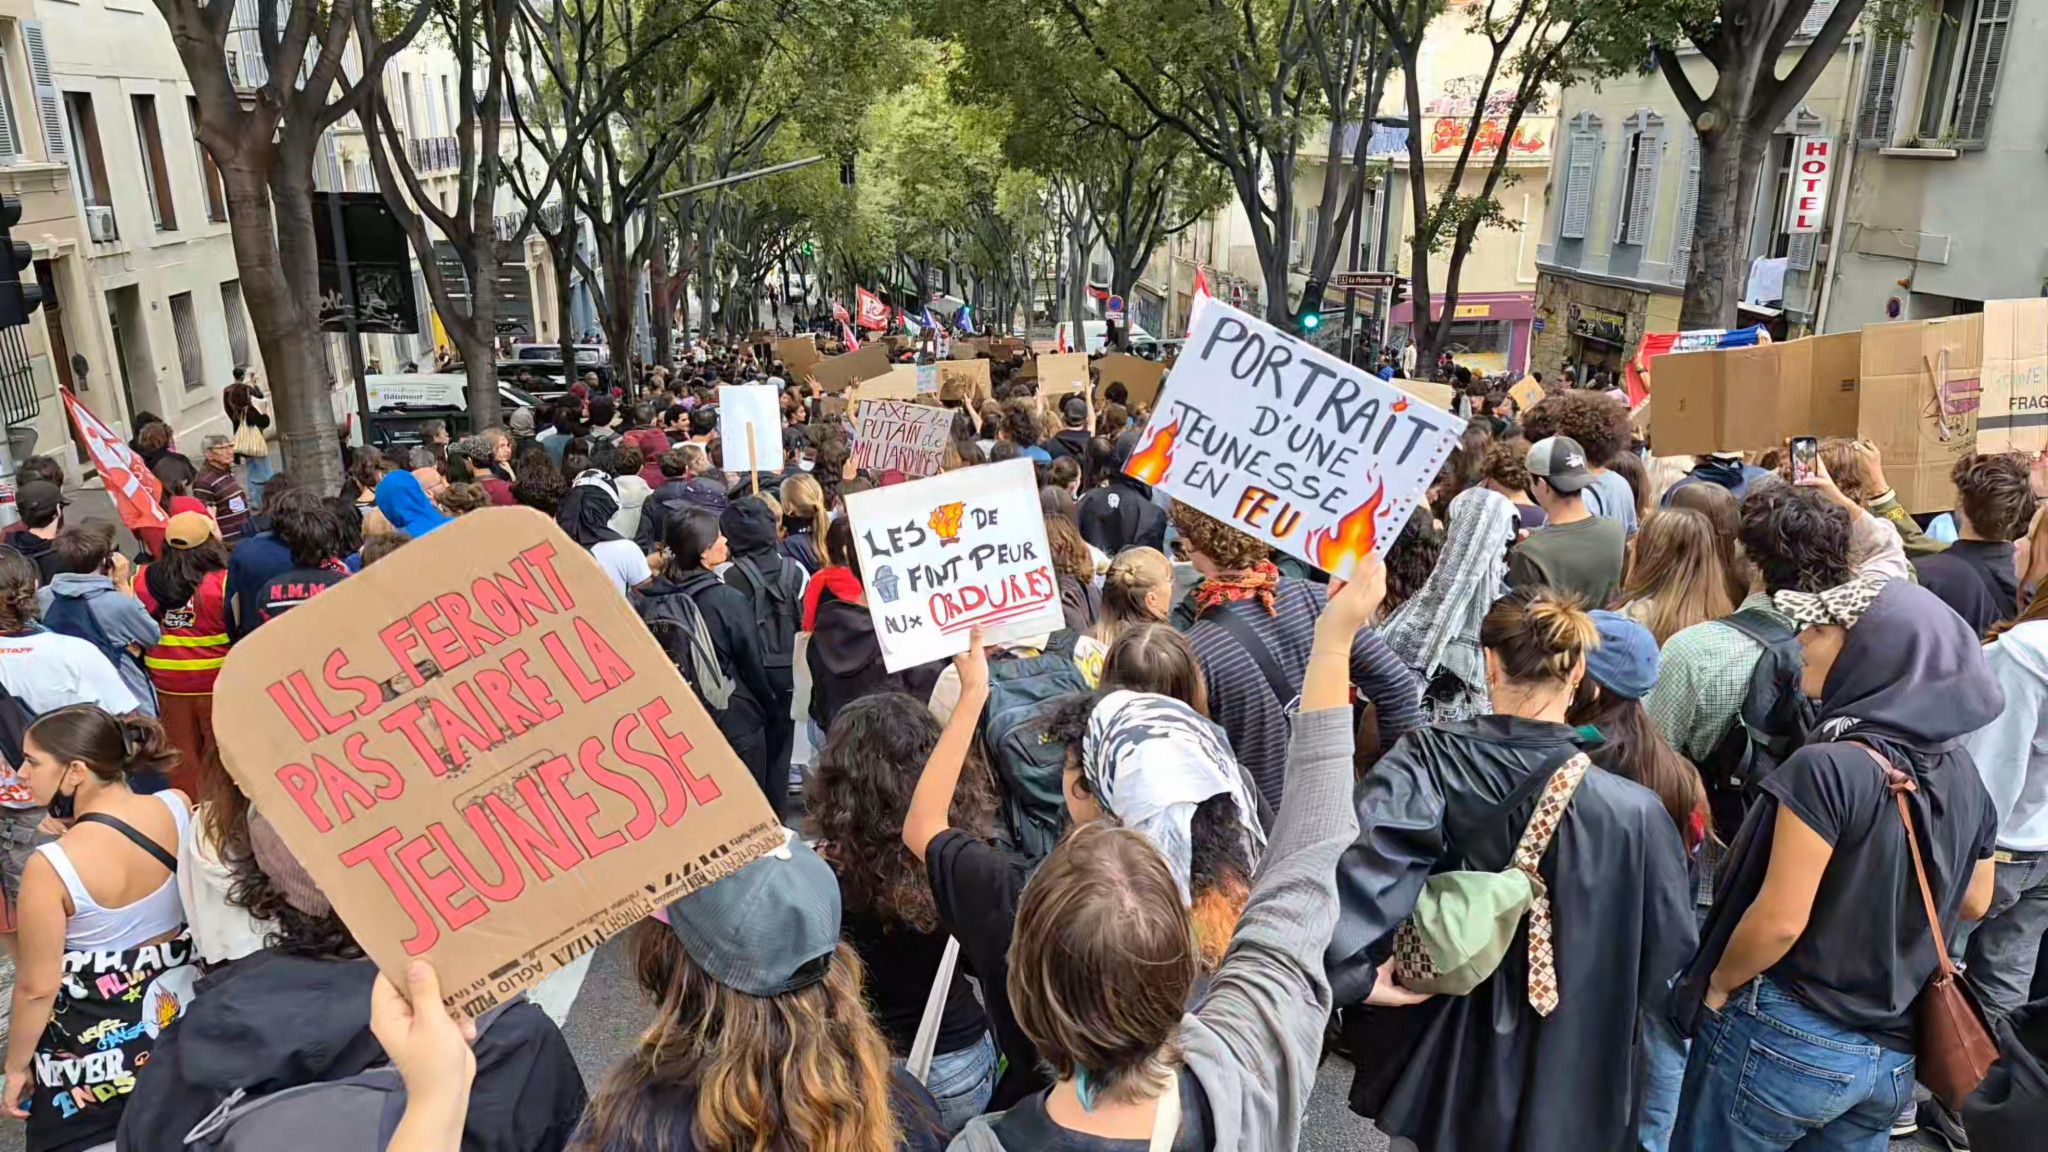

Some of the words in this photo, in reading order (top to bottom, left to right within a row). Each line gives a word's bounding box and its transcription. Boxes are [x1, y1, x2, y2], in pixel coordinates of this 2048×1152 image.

[1797, 142, 1828, 228] HOTEL
[862, 400, 932, 424] TAXEZ
[1201, 317, 1438, 465] PORTRAIT
[853, 440, 945, 477] MILLIARDAIRES
[862, 418, 922, 444] PUTAIN
[1175, 401, 1348, 514] JEUNESSE
[1250, 406, 1358, 478] D'UNE
[863, 519, 927, 559] LES
[971, 508, 999, 531] DE
[1184, 461, 1229, 498] EN
[1233, 485, 1301, 539] FEU
[907, 555, 963, 592] FONT
[969, 541, 1038, 571] PEUR
[929, 566, 1054, 627] ORDURES
[266, 648, 382, 743] ILS
[379, 541, 576, 686] FERONT
[276, 733, 406, 832] PAS
[380, 648, 564, 777] TAIRE
[541, 616, 636, 703] LA
[339, 697, 722, 957] JEUNESSE
[495, 959, 546, 995] AGLIO
